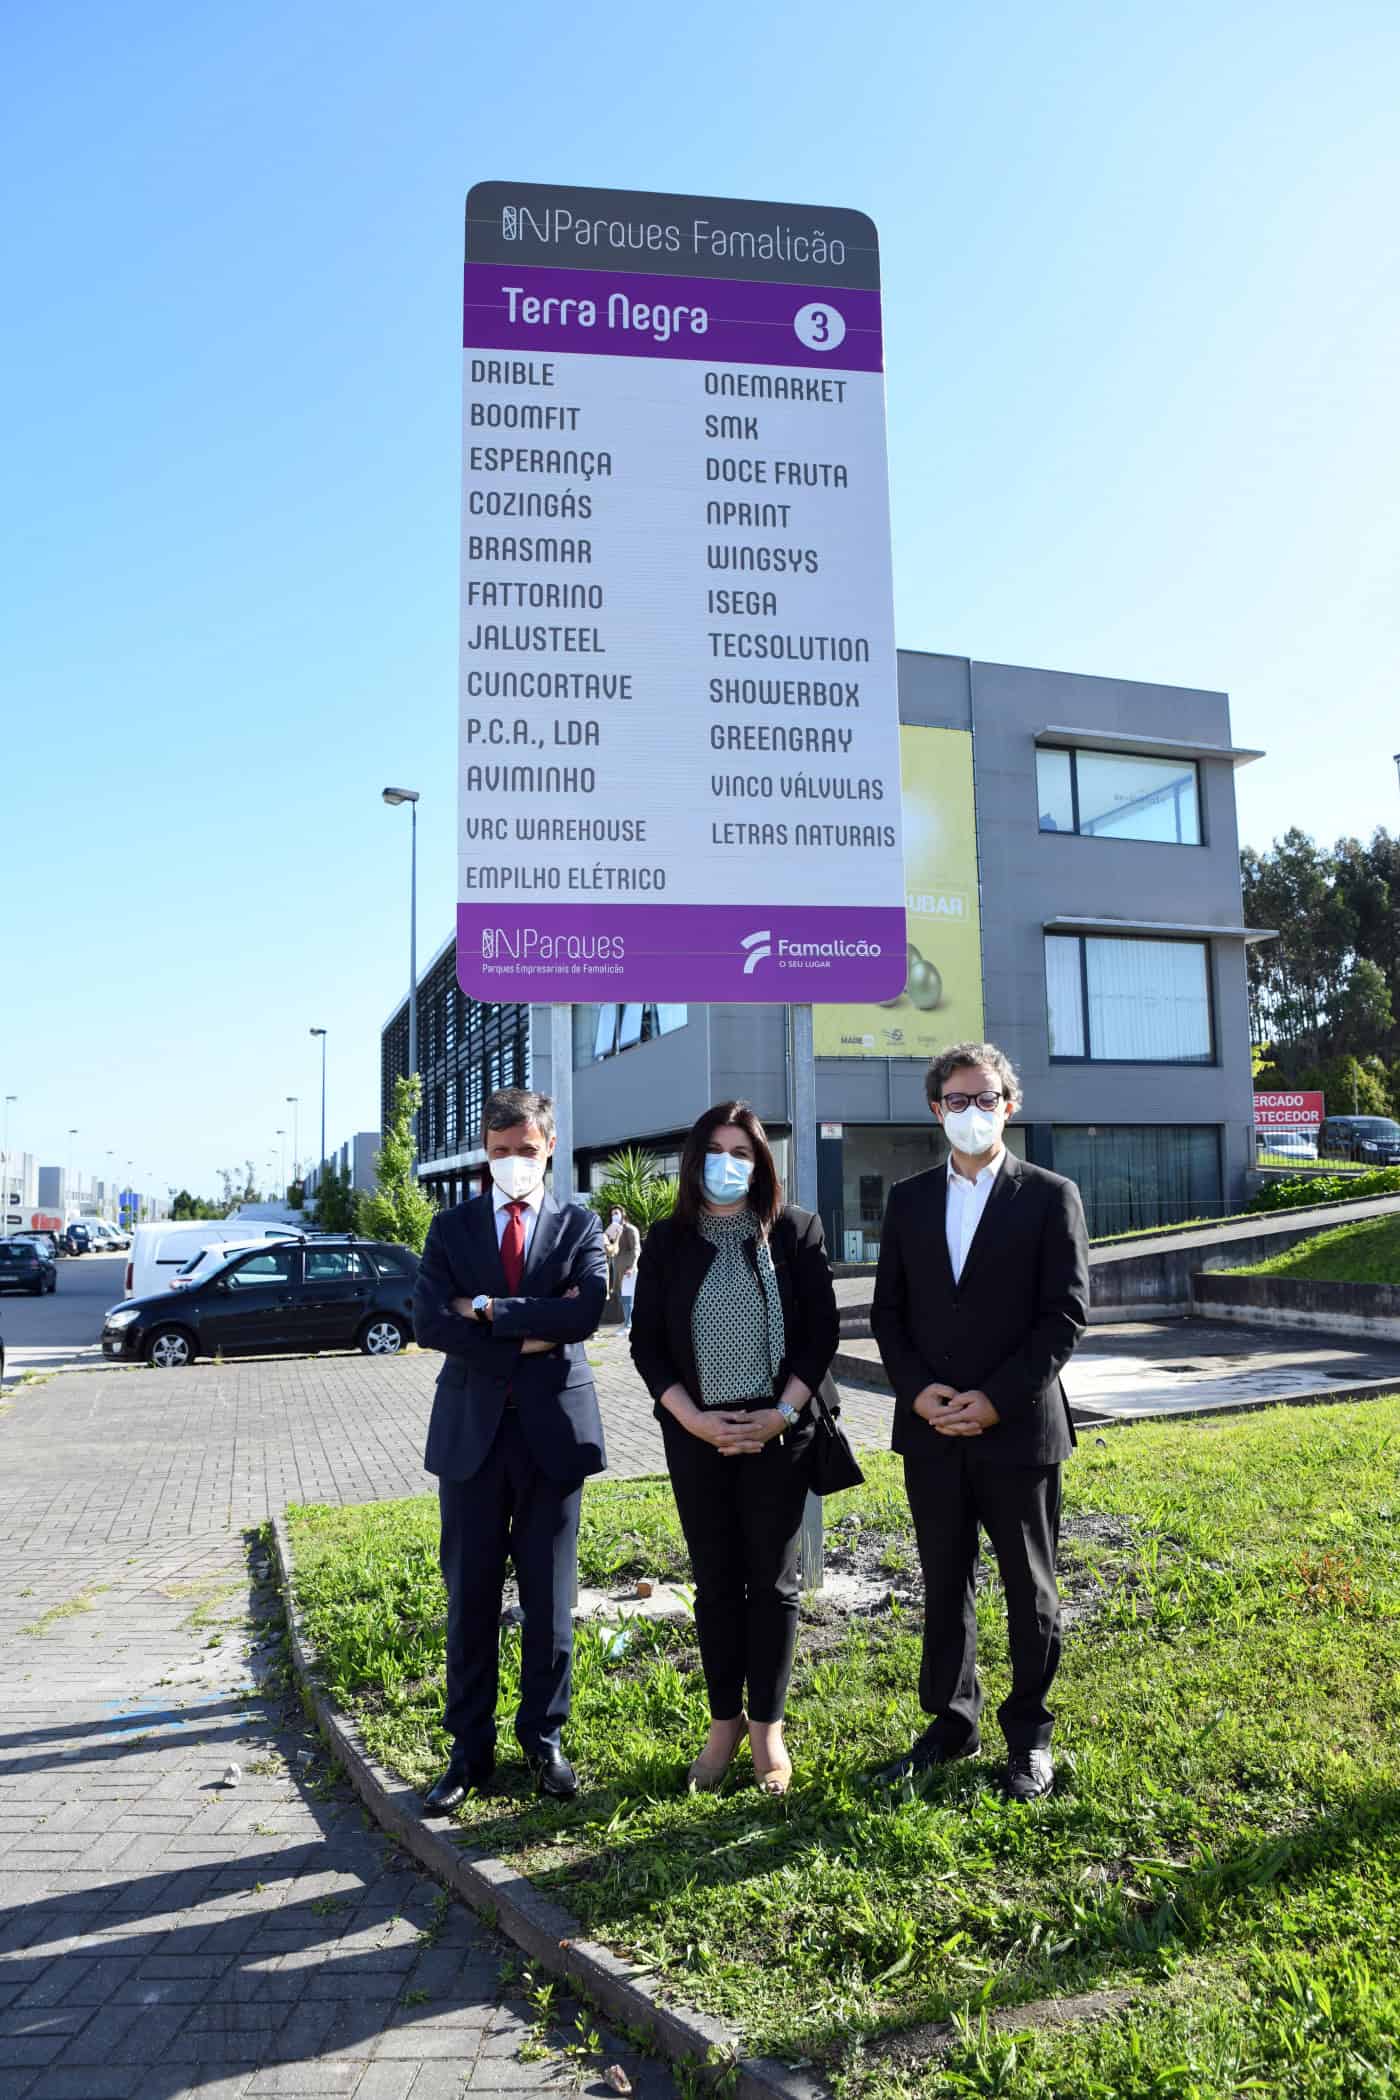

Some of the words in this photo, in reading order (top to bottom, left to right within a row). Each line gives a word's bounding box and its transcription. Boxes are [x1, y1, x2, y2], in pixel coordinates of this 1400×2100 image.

[693, 220, 845, 265] Famalicão
[502, 286, 596, 328] Terra
[608, 293, 708, 342] Negra
[811, 311, 830, 343] 3
[472, 360, 554, 386] DRIBLE
[705, 372, 847, 403] ONEMARKET
[471, 403, 581, 431] BOOMFIT
[705, 415, 758, 440] SMK
[471, 447, 611, 481] ESPERANÇA
[706, 458, 767, 483] DOCE
[775, 462, 847, 488] FRUTA
[470, 488, 592, 519] COZINGÁS
[707, 501, 791, 528] NPRINT
[469, 536, 591, 563] BRASMAR
[708, 545, 818, 573] WINGSYS
[468, 582, 602, 609] FATTORINO
[708, 590, 776, 616] ISEGA
[468, 624, 605, 652] JALUSTEEL
[708, 633, 869, 662] TECSOLUTION
[468, 672, 632, 699] CUNCORTAVE
[710, 679, 859, 707] SHOWERBOX
[468, 718, 544, 749] P.C.A.,
[555, 720, 599, 746] LDA
[711, 725, 852, 752] GREENGRAY
[468, 766, 595, 793] AVIMINHO
[712, 775, 773, 798] VINCO
[780, 771, 884, 801] VÁLVULAS
[467, 818, 507, 840] VRC
[516, 819, 646, 841] WAREHOUSE
[712, 823, 788, 845] LETRAS
[795, 824, 896, 848] NATURAIS
[467, 867, 560, 889] EMPILHO
[569, 862, 665, 890] ELÉTRICO
[907, 895, 962, 915] UBAR
[778, 939, 882, 957] Famalicão
[482, 964, 514, 976] Parques
[515, 964, 569, 976] Empresariais
[571, 964, 581, 974] de
[583, 963, 624, 974] Famalicão
[779, 960, 786, 968] O
[787, 960, 803, 968] SEU
[804, 960, 831, 969] LUGAR
[1253, 1095, 1304, 1107] ERCADO
[1253, 1110, 1320, 1122] STECEDOR
